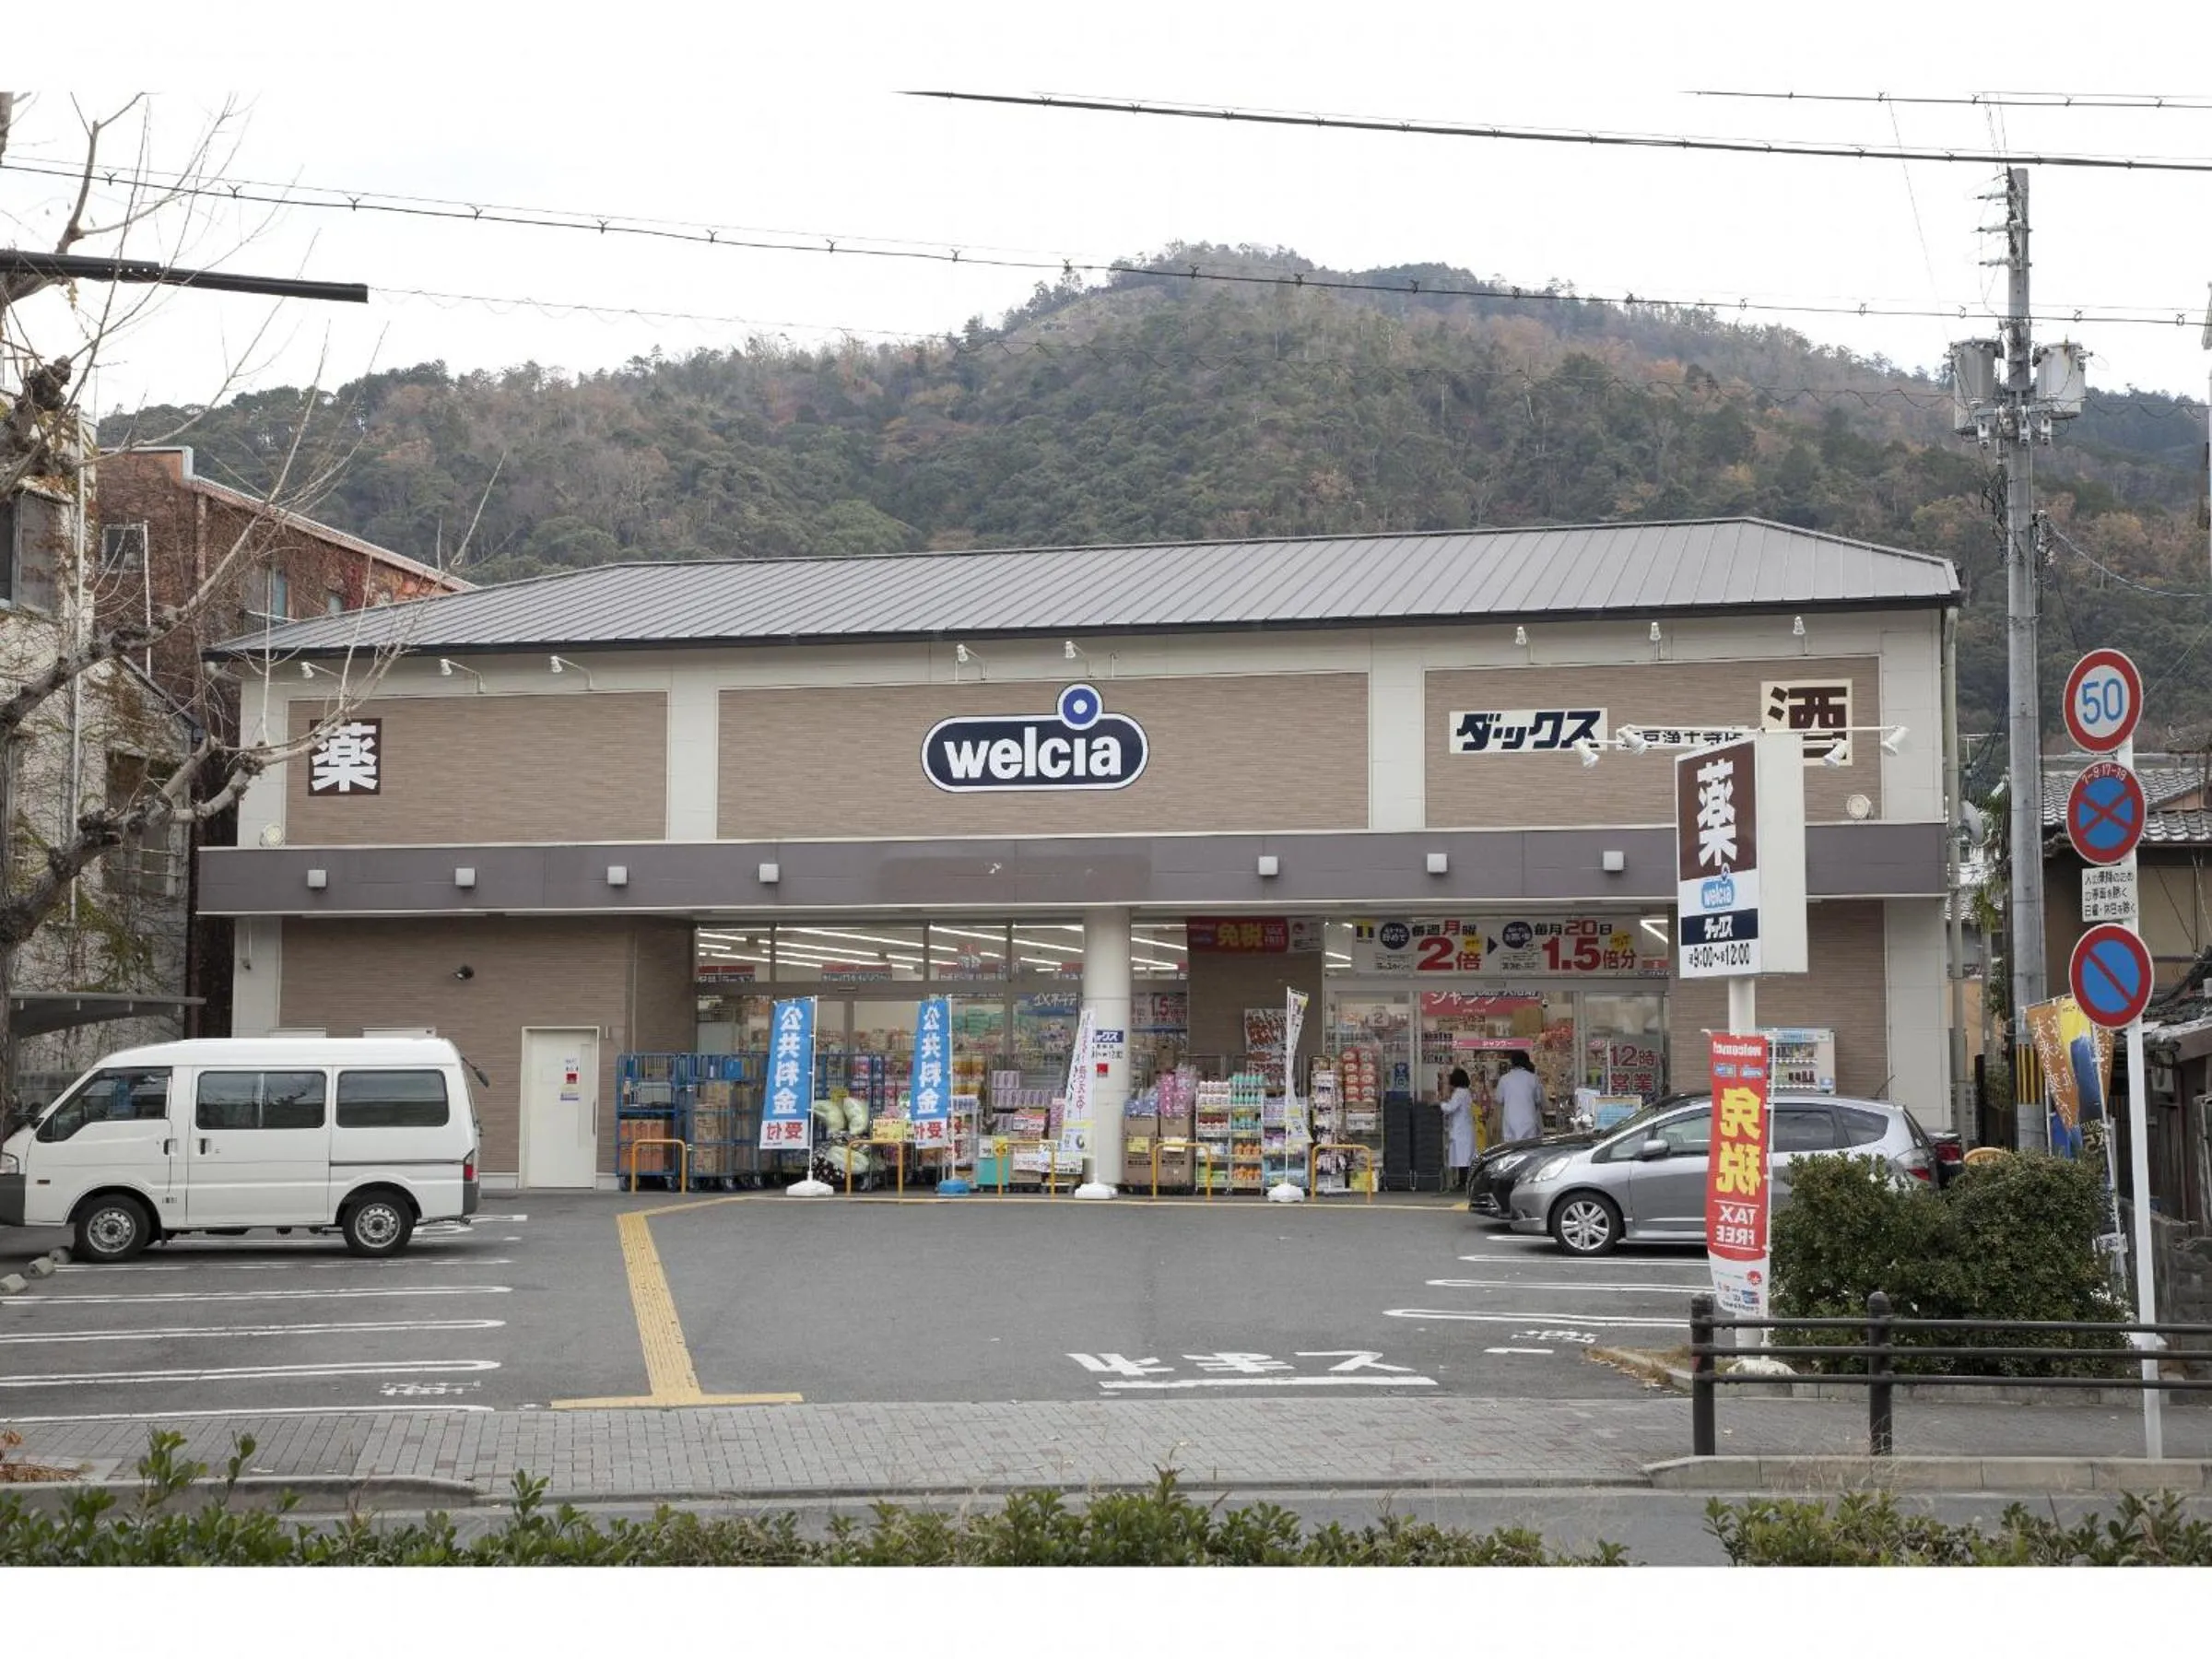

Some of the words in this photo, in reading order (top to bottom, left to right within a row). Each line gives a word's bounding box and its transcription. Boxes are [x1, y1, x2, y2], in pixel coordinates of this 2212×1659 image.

[2081, 678, 2124, 724] 50
[943, 688, 1123, 780] welcia
[1456, 711, 1601, 751] ダックス
[1769, 685, 1848, 760] 酒
[311, 721, 378, 792] 薬
[1697, 759, 1738, 866] 薬
[1217, 923, 1264, 947] 免税
[1535, 920, 1613, 936] 毎月20日
[1703, 915, 1734, 939] ダックス
[1417, 936, 1482, 971] 2倍
[1542, 936, 1637, 971] 1.5倍分
